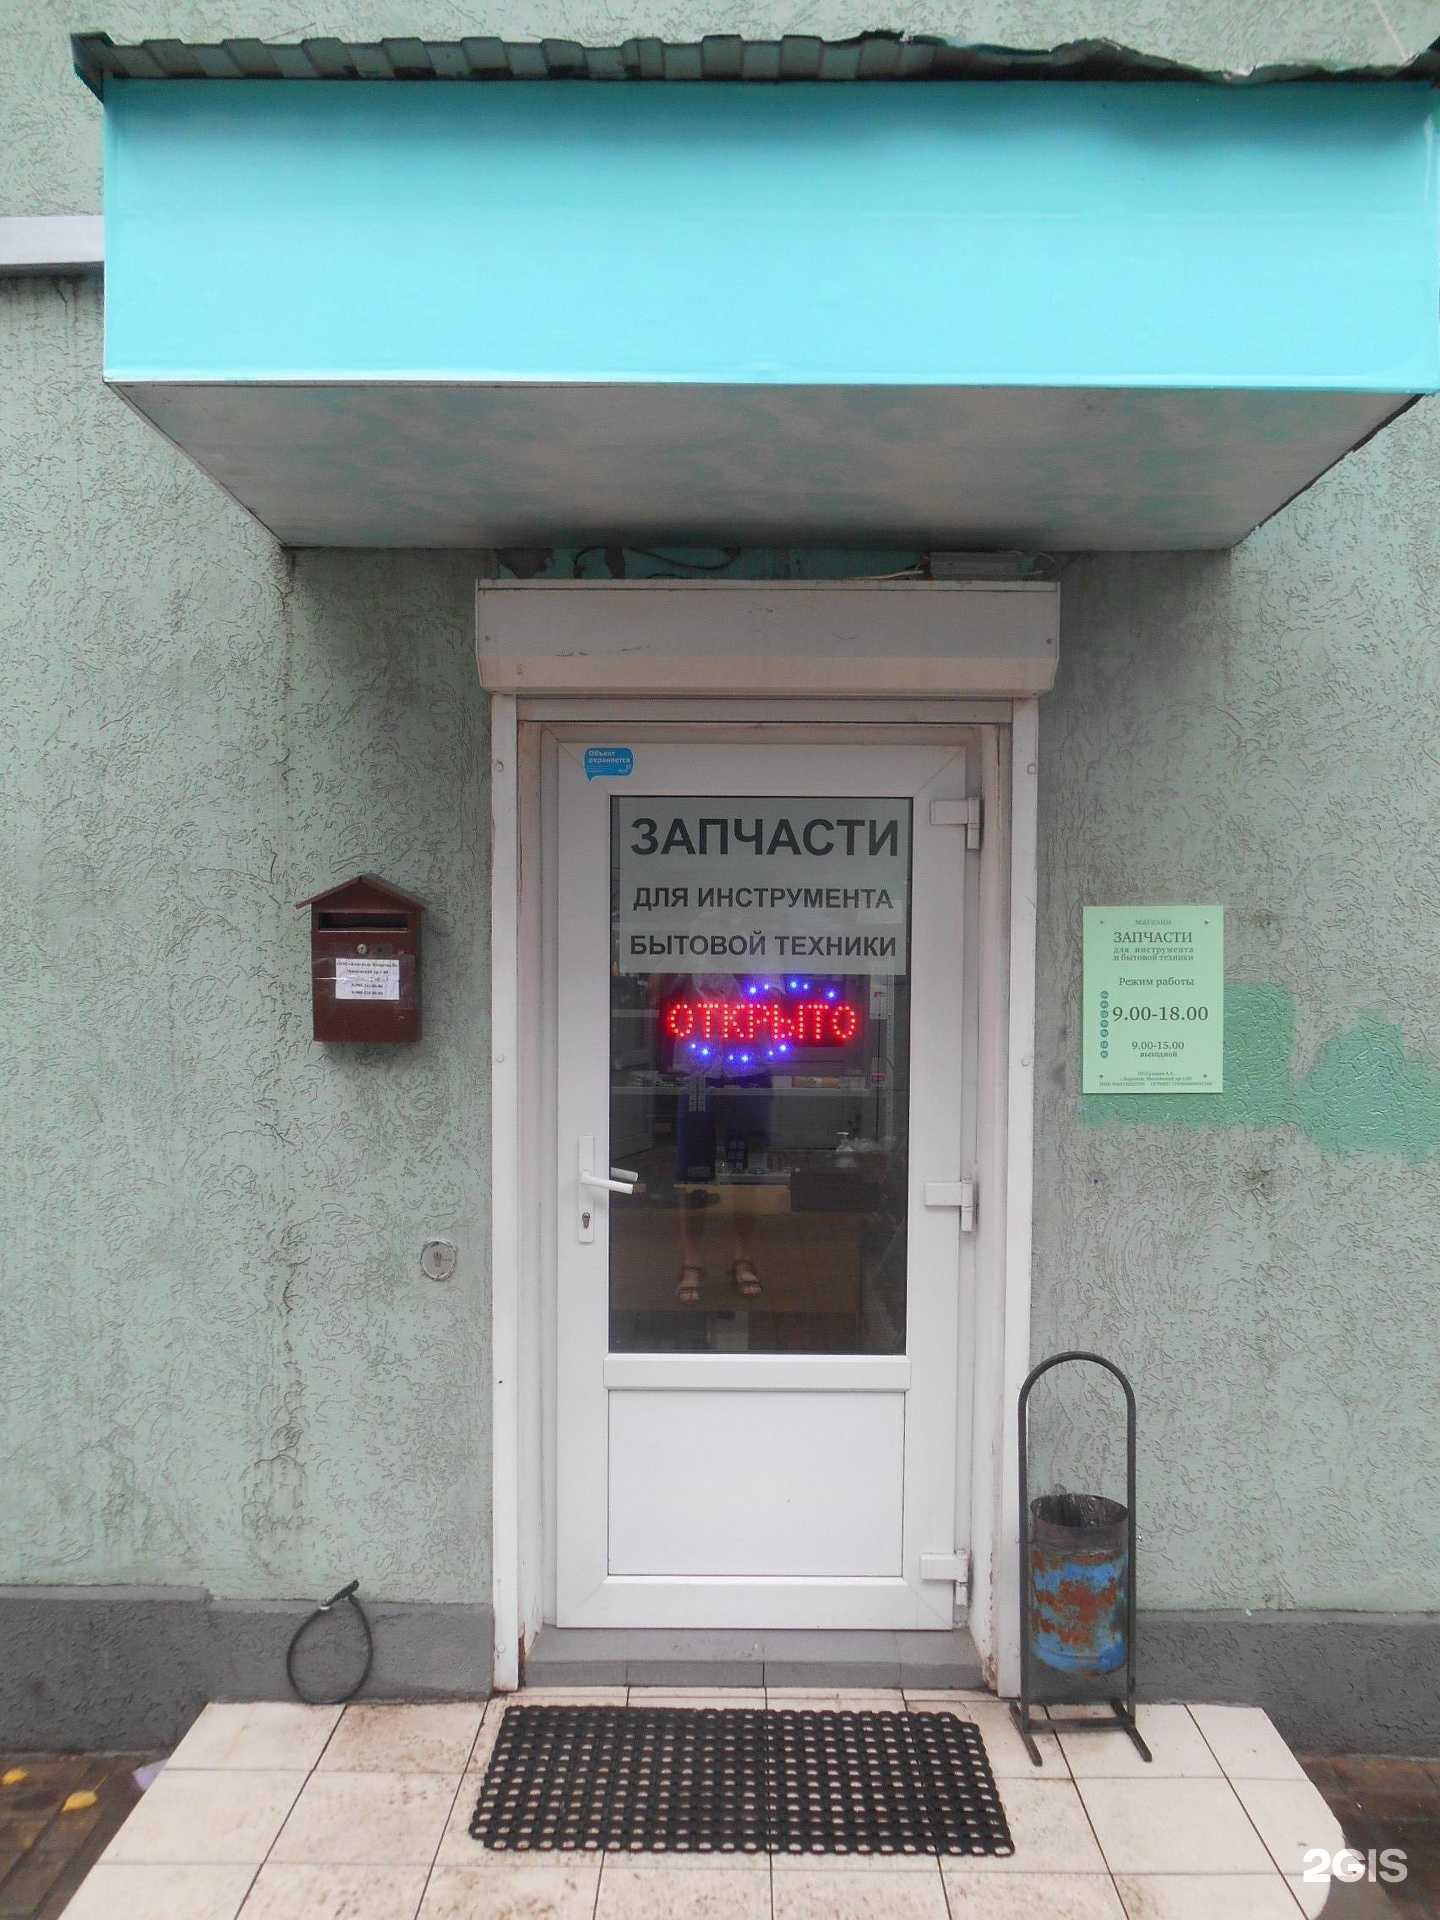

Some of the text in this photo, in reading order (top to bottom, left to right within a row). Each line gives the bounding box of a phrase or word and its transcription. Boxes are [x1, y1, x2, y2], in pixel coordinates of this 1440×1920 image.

[631, 818, 898, 857] ЗАПЧАСТИ
[633, 887, 894, 911] ДЛЯ ИНСТРУМЕНТА
[630, 931, 896, 957] БЫТОВОЙ ТЕХНИКИ
[1113, 931, 1192, 943] ЗАПЧАСТИ
[1121, 953, 1157, 961] бытовой
[1119, 976, 1195, 988] Режим работы
[667, 1002, 858, 1040] ОТКРЫТО
[1112, 1006, 1209, 1022] 9.00-18.00
[1131, 1041, 1185, 1050] 9.00-15.00
